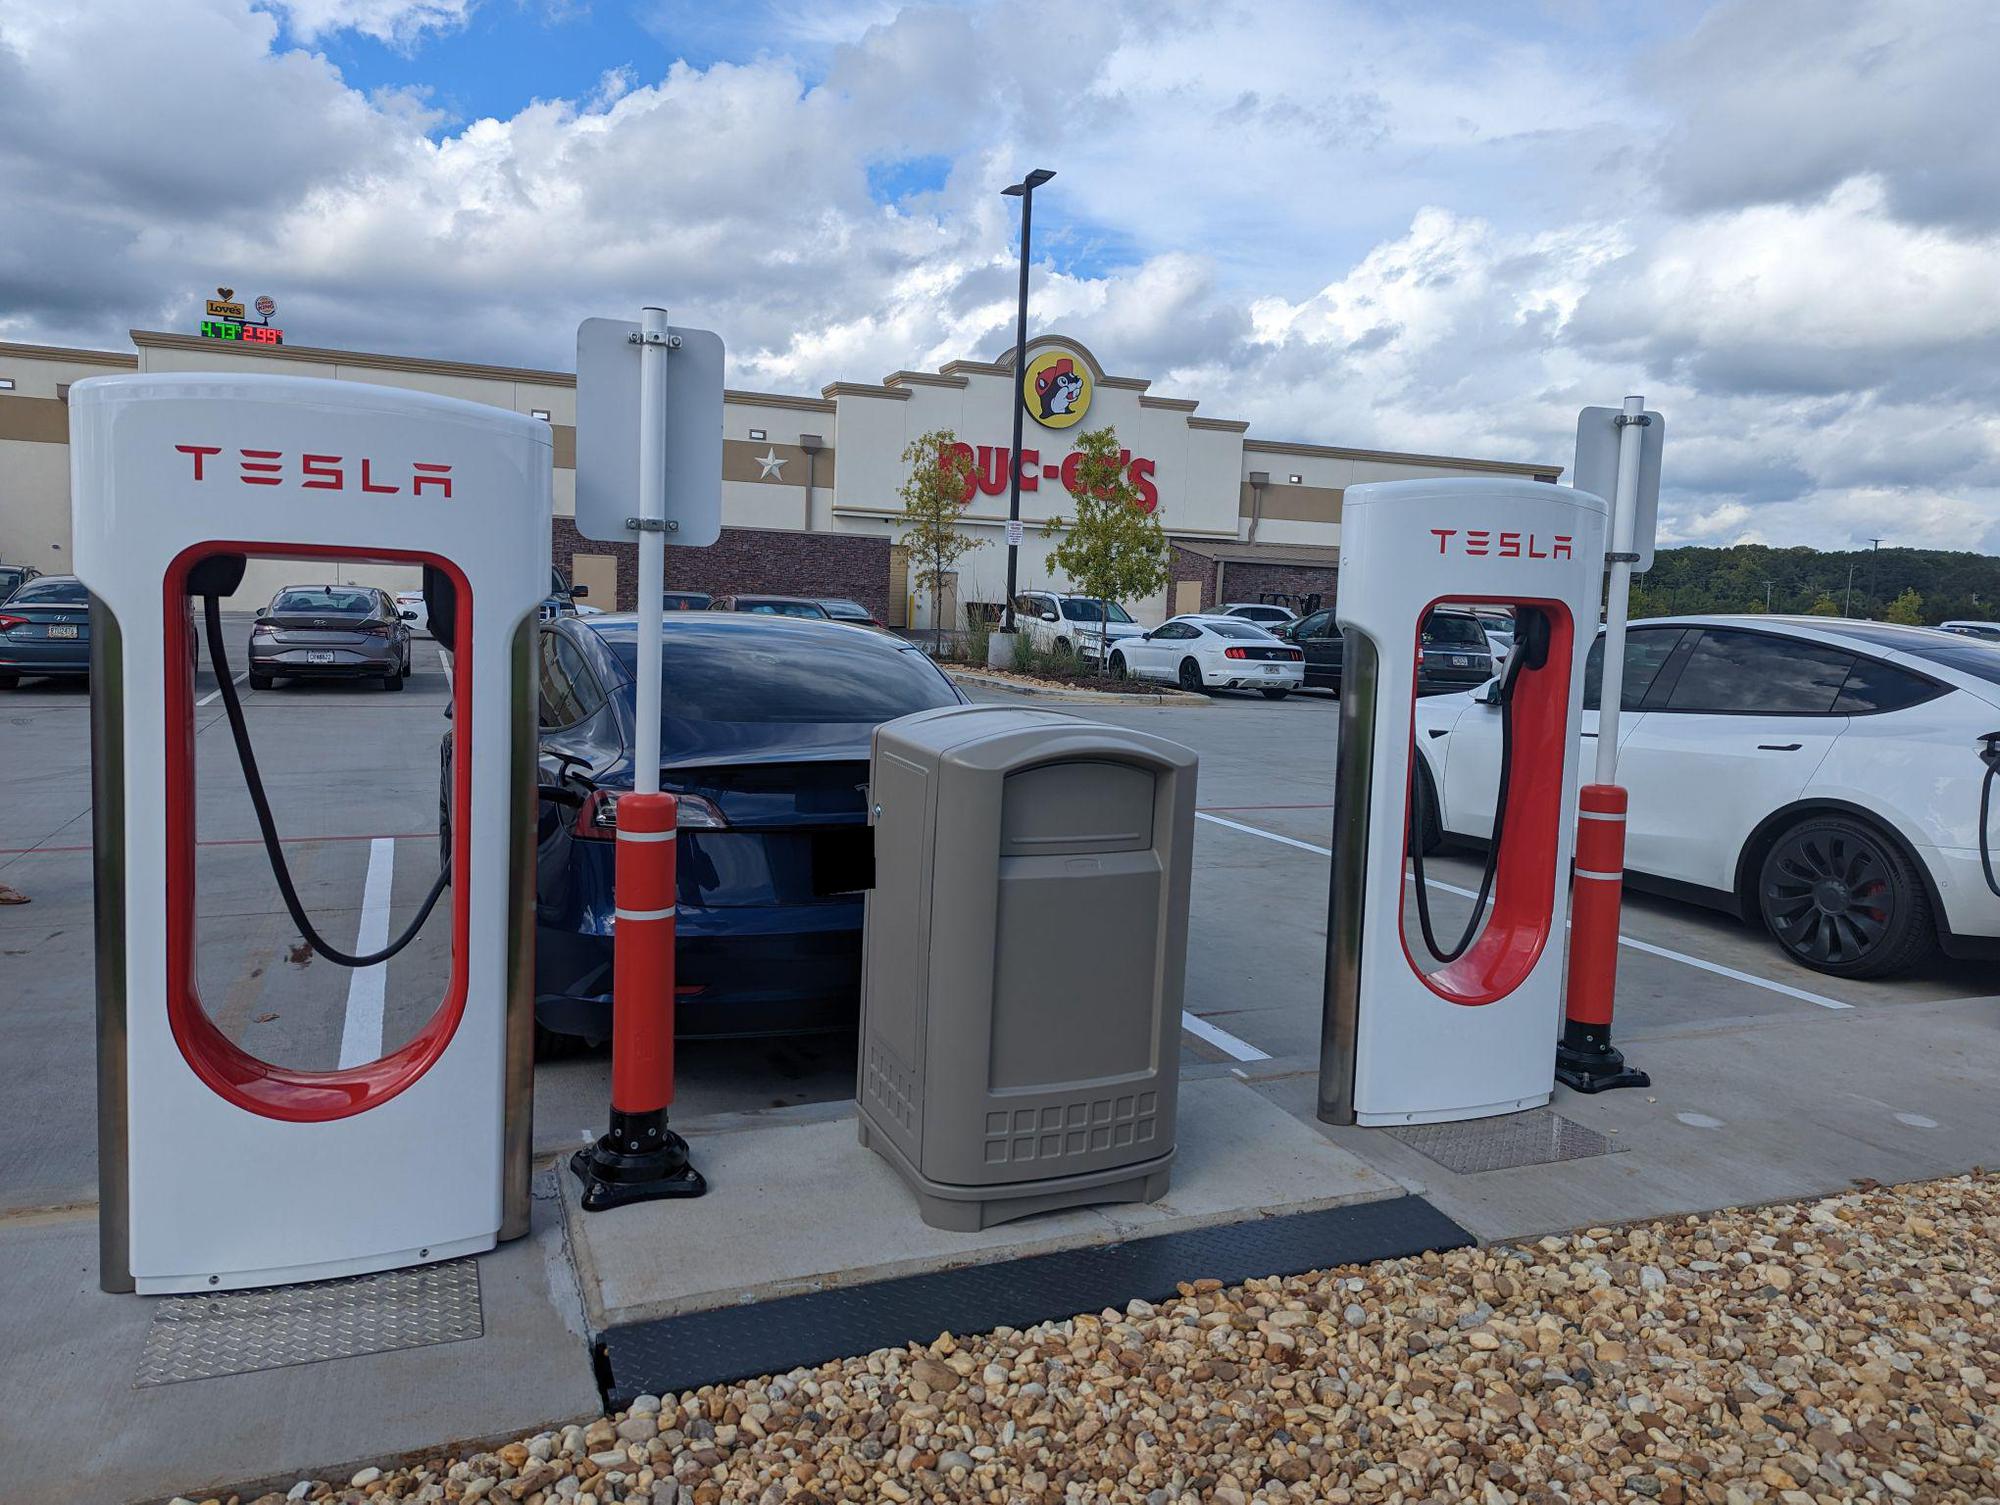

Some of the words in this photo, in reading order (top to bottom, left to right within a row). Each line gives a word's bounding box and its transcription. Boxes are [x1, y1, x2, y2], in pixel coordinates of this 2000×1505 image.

[209, 302, 242, 315] Love's
[174, 445, 453, 498] TESLA
[1430, 529, 1573, 560] TESLA
